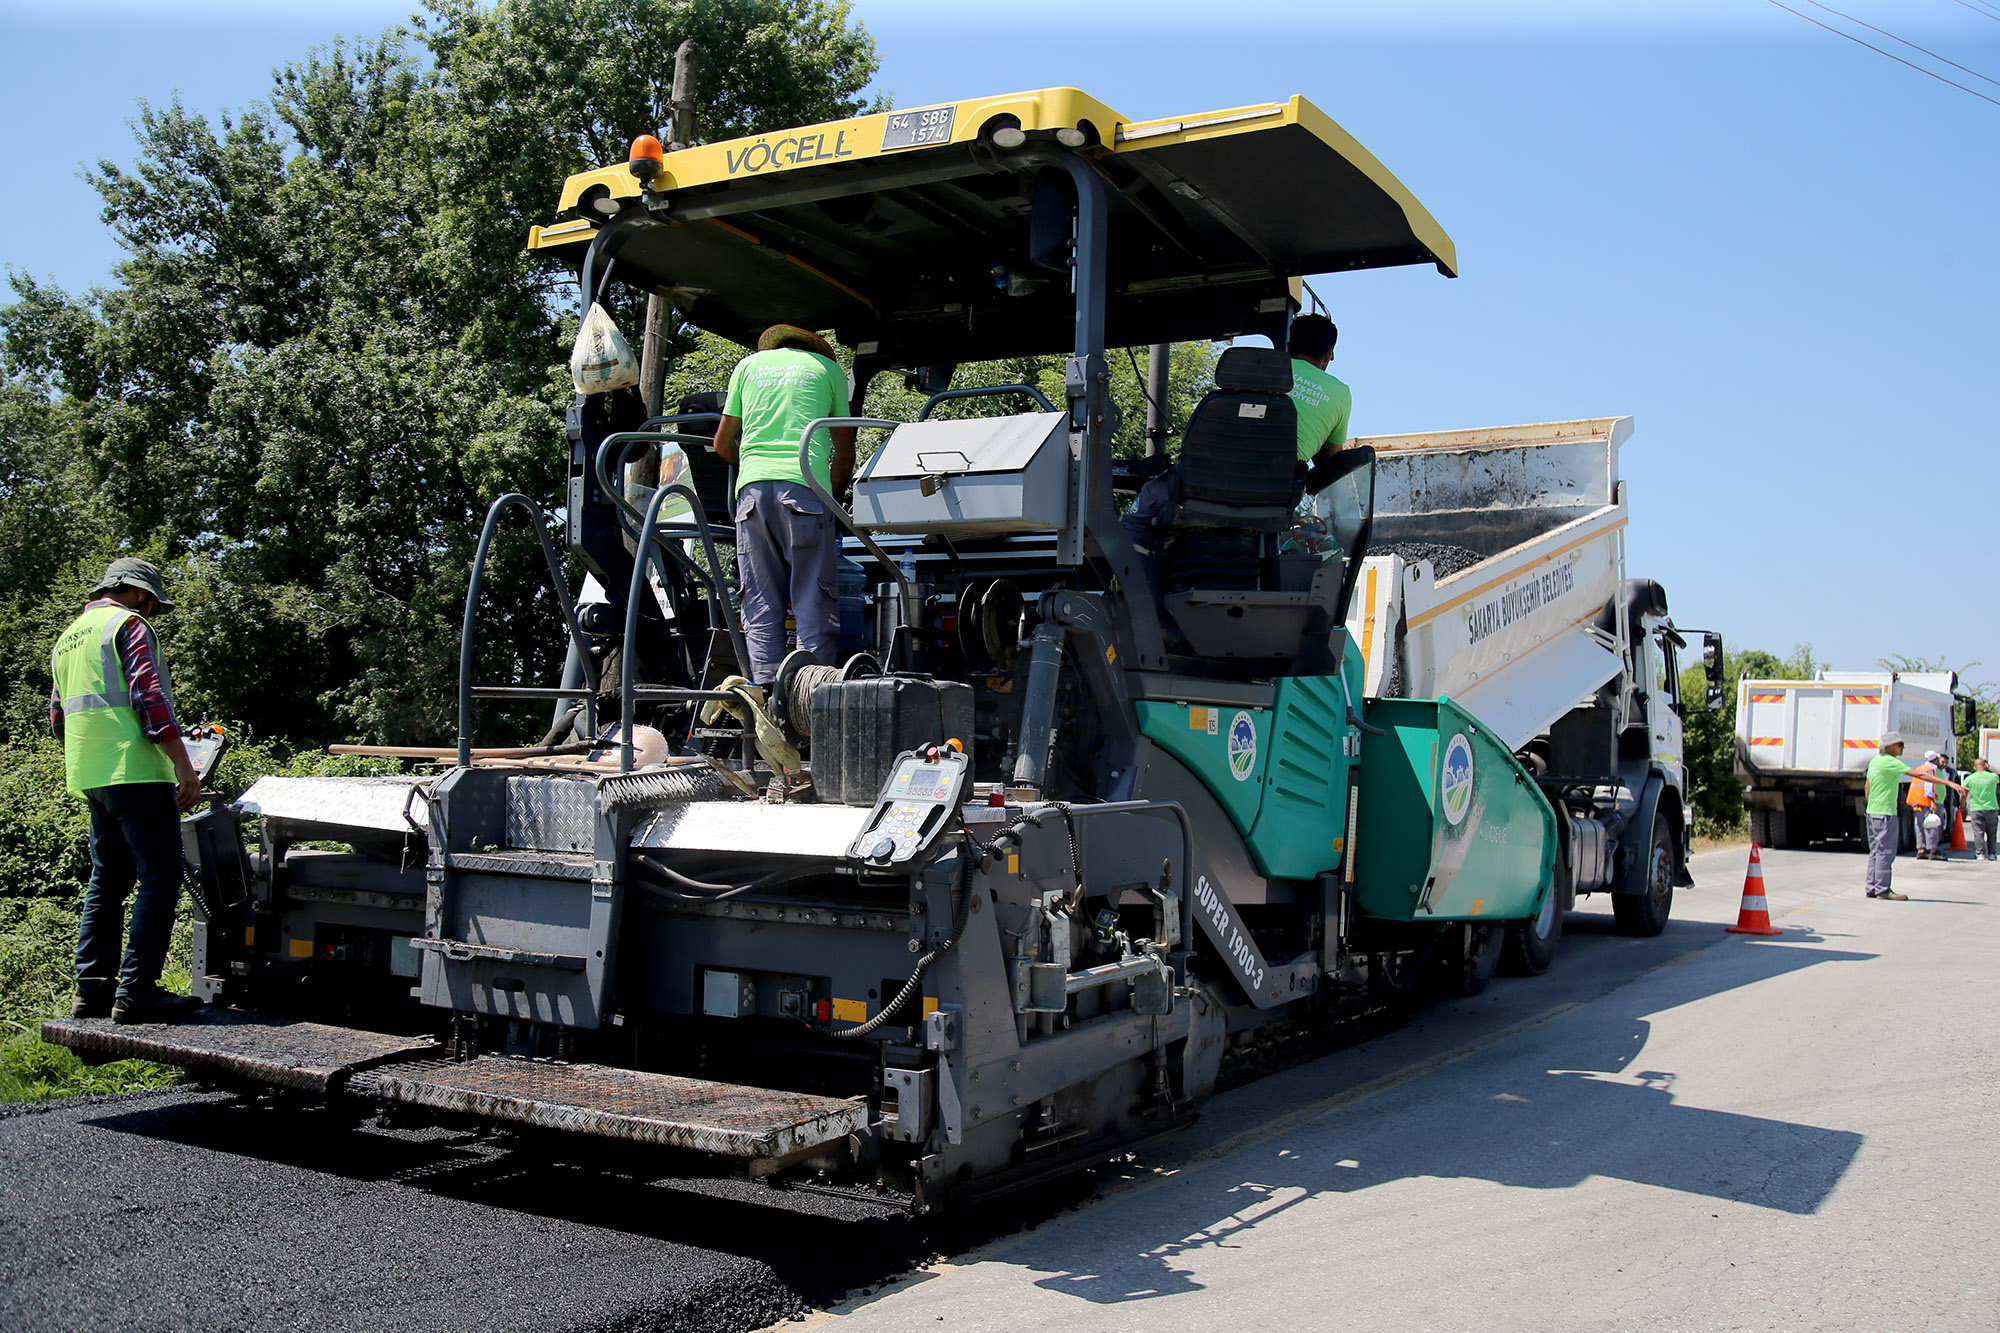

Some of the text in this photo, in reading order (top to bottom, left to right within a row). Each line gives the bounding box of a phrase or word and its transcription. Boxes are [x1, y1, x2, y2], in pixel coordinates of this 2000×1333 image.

[891, 110, 949, 131] 54 SBB
[910, 127, 944, 143] 1574
[1293, 374, 1323, 392] KARYA
[1468, 552, 1574, 646] SAKARYA BÜYÜKŞEHİR BELEDİYESİ
[1194, 875, 1264, 990] SUPER 1900-3
